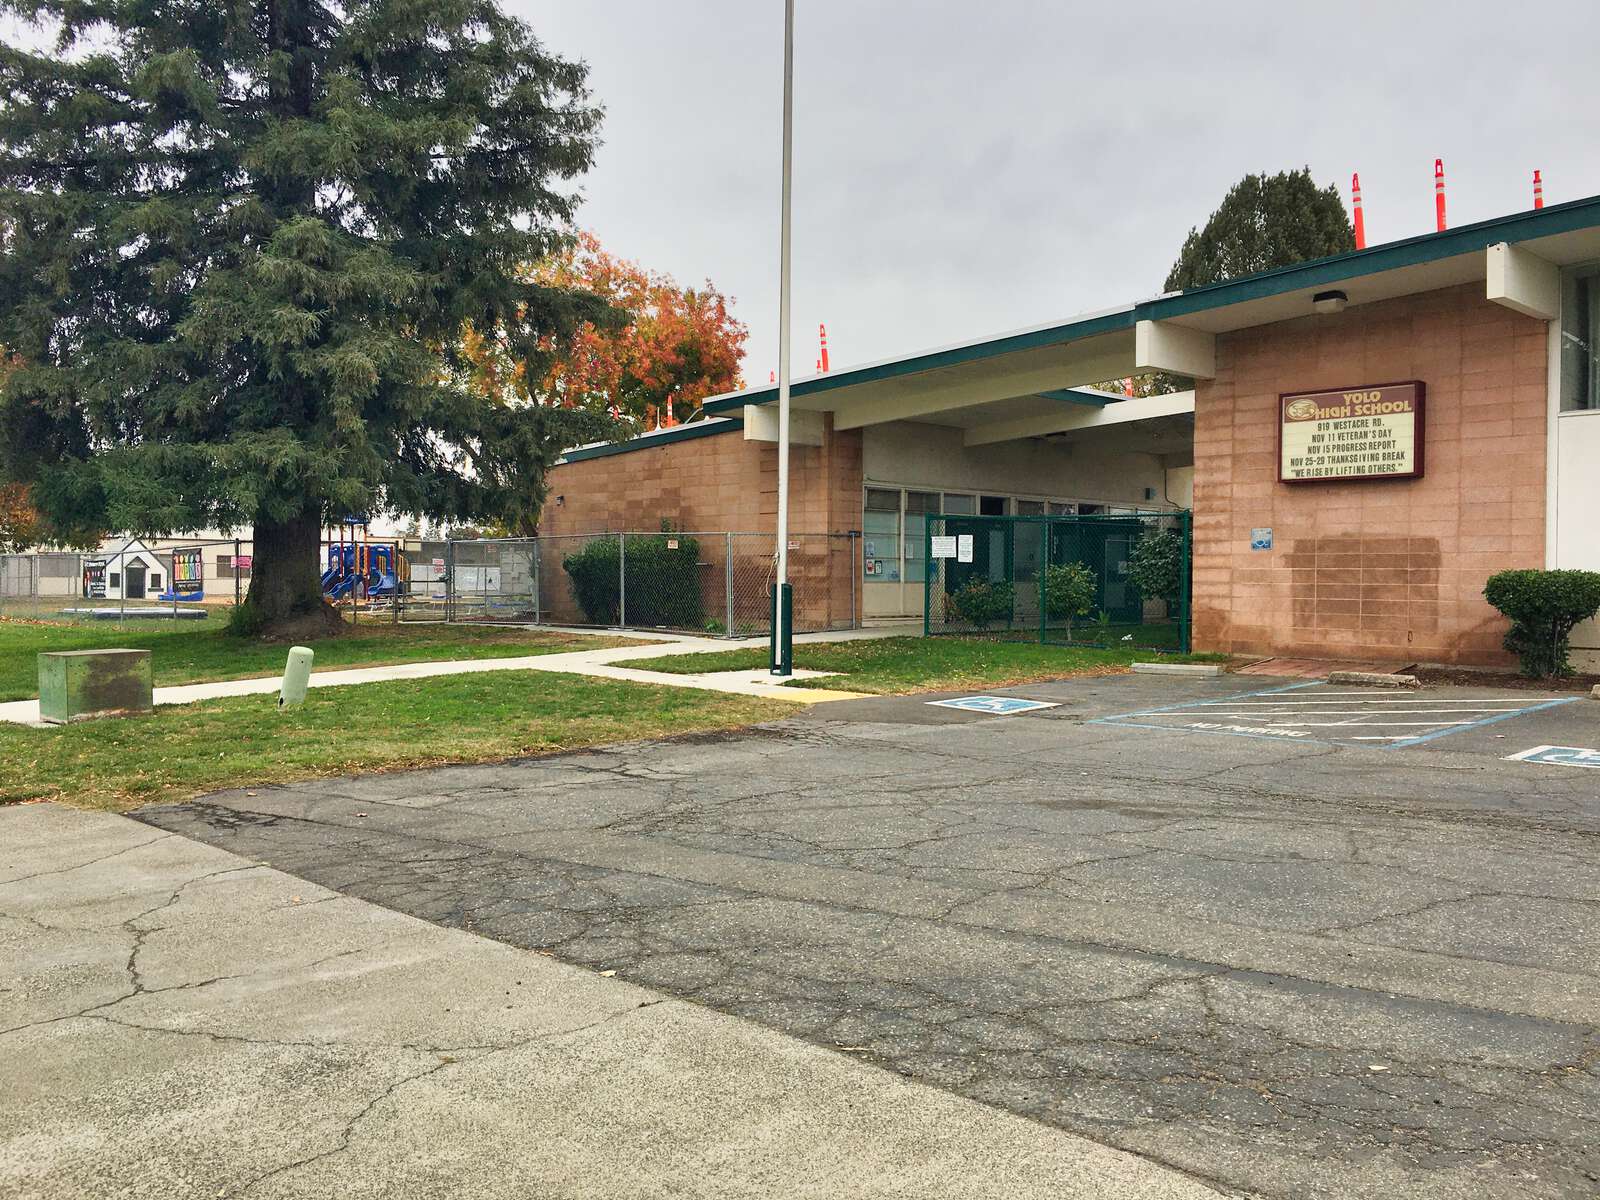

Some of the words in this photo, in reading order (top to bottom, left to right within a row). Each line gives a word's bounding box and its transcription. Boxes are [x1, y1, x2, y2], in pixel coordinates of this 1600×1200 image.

[1343, 391, 1381, 405] YOLO
[1315, 405, 1351, 420] HIGH
[1354, 400, 1412, 416] SCHOOL
[1317, 422, 1330, 431] 919
[1333, 418, 1369, 430] WESTACRE
[1372, 418, 1385, 427] RD.
[1311, 434, 1325, 443] NOV
[1328, 433, 1335, 442] 11
[1337, 430, 1377, 441] VETERAN'S
[1378, 429, 1392, 438] DAY
[1307, 445, 1321, 454] NOV
[1323, 444, 1331, 453] 15
[1332, 442, 1367, 453] PROGRESS
[1368, 440, 1396, 450] REPORT
[1290, 457, 1304, 467] NOV
[1305, 456, 1325, 466] 25-29
[1327, 452, 1380, 464] THANKSGIVING
[1382, 451, 1405, 461] BREAK
[1306, 467, 1323, 476] RISE
[1324, 466, 1334, 476] BY
[1336, 465, 1366, 475] LIFTING
